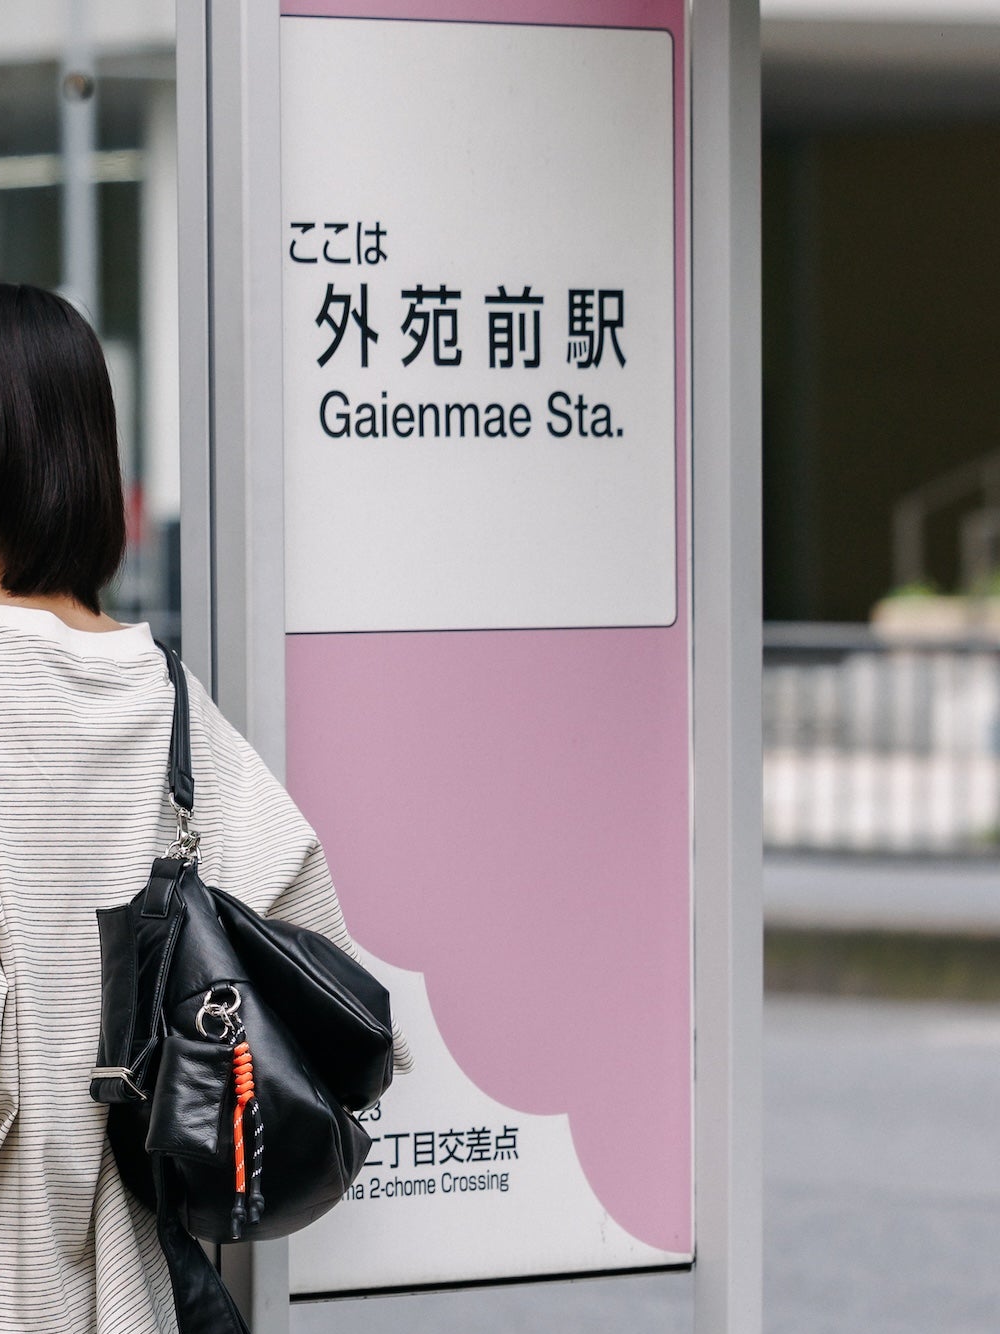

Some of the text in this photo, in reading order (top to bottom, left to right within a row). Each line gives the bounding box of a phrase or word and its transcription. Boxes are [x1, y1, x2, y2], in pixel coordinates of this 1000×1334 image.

[289, 221, 388, 265] ここは
[315, 282, 627, 369] 外苑前駅
[319, 390, 624, 438] Gaienmae Sta.
[369, 1176, 436, 1199] 2-chome
[441, 1169, 509, 1193] Crossing
